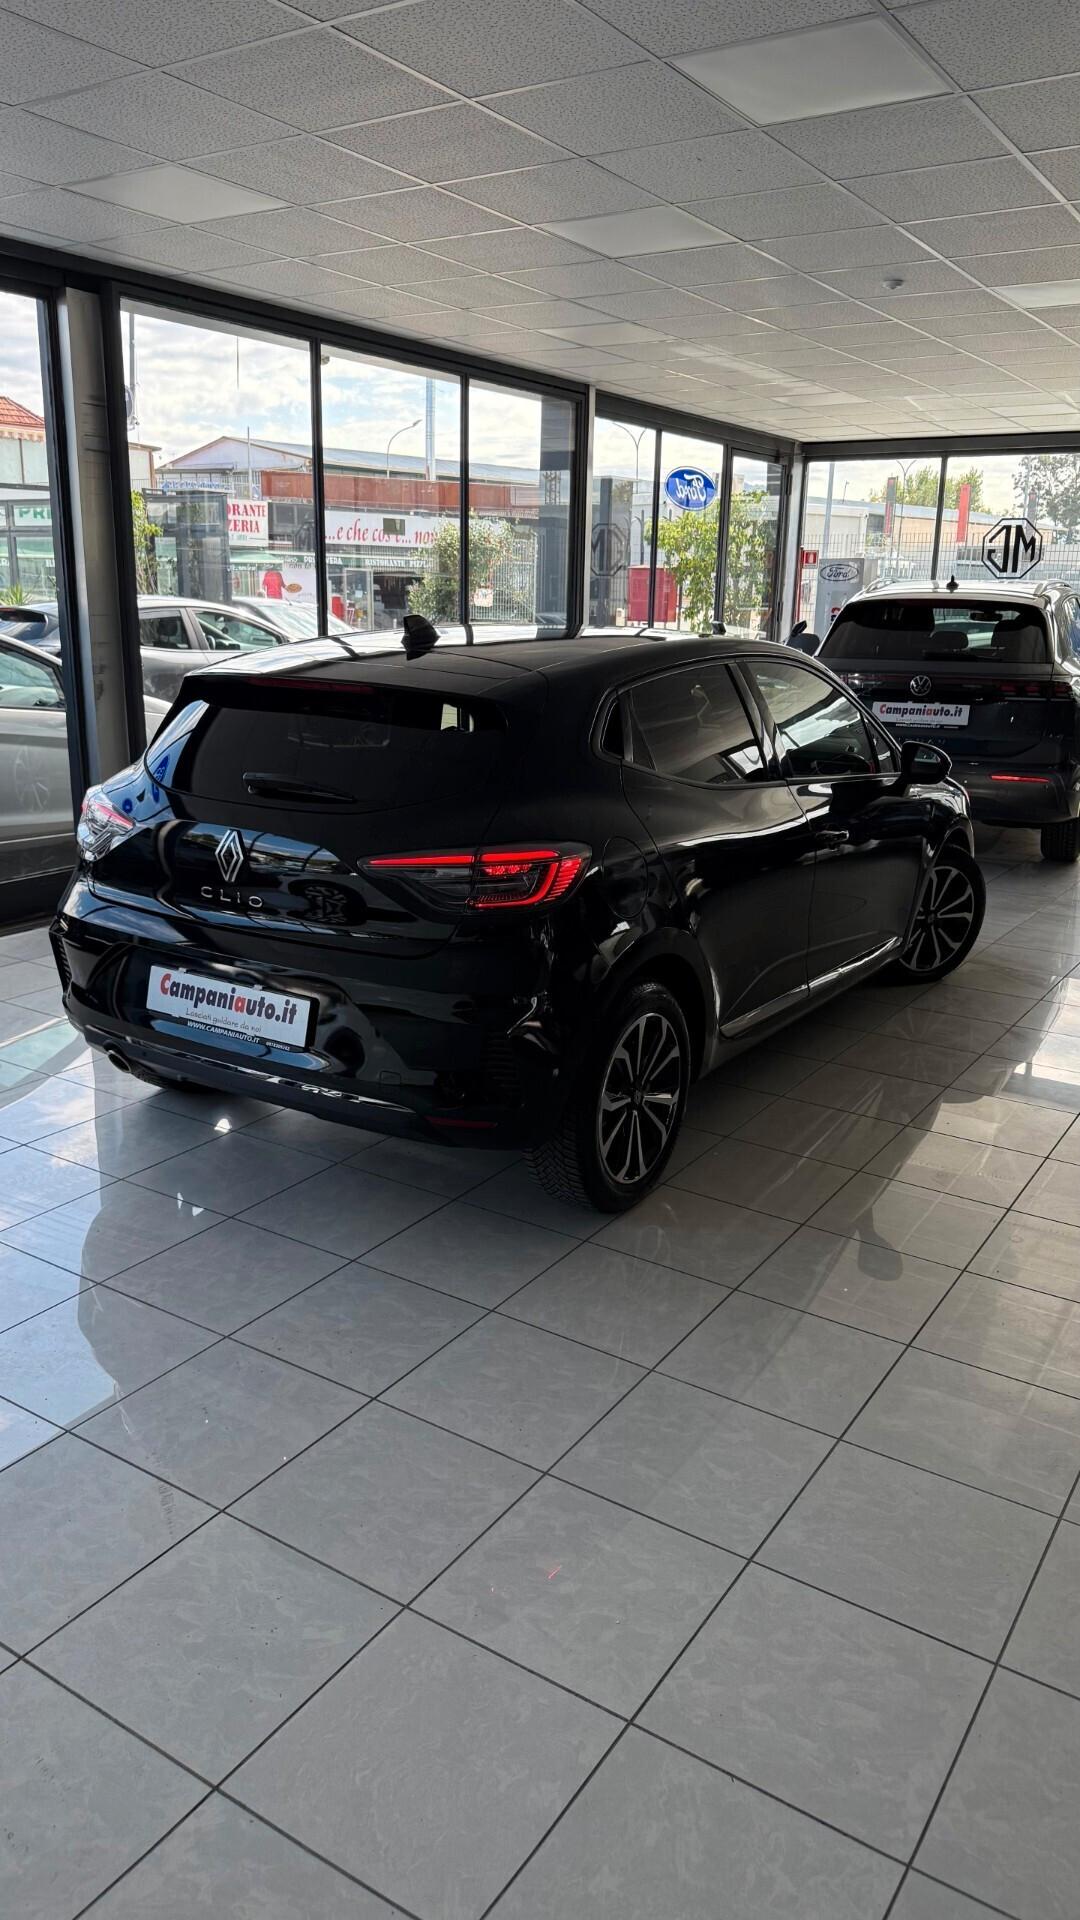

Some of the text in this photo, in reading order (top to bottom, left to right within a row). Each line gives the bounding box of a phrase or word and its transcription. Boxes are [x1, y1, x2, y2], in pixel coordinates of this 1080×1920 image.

[347, 518, 369, 541] che
[826, 566, 849, 579] Ford
[880, 703, 963, 717] Campaniauto.it
[200, 886, 263, 908] CLIO
[160, 973, 298, 1025] Campaniauto.it
[187, 1020, 260, 1044] WWW.CAMPANIAUTO.IT
